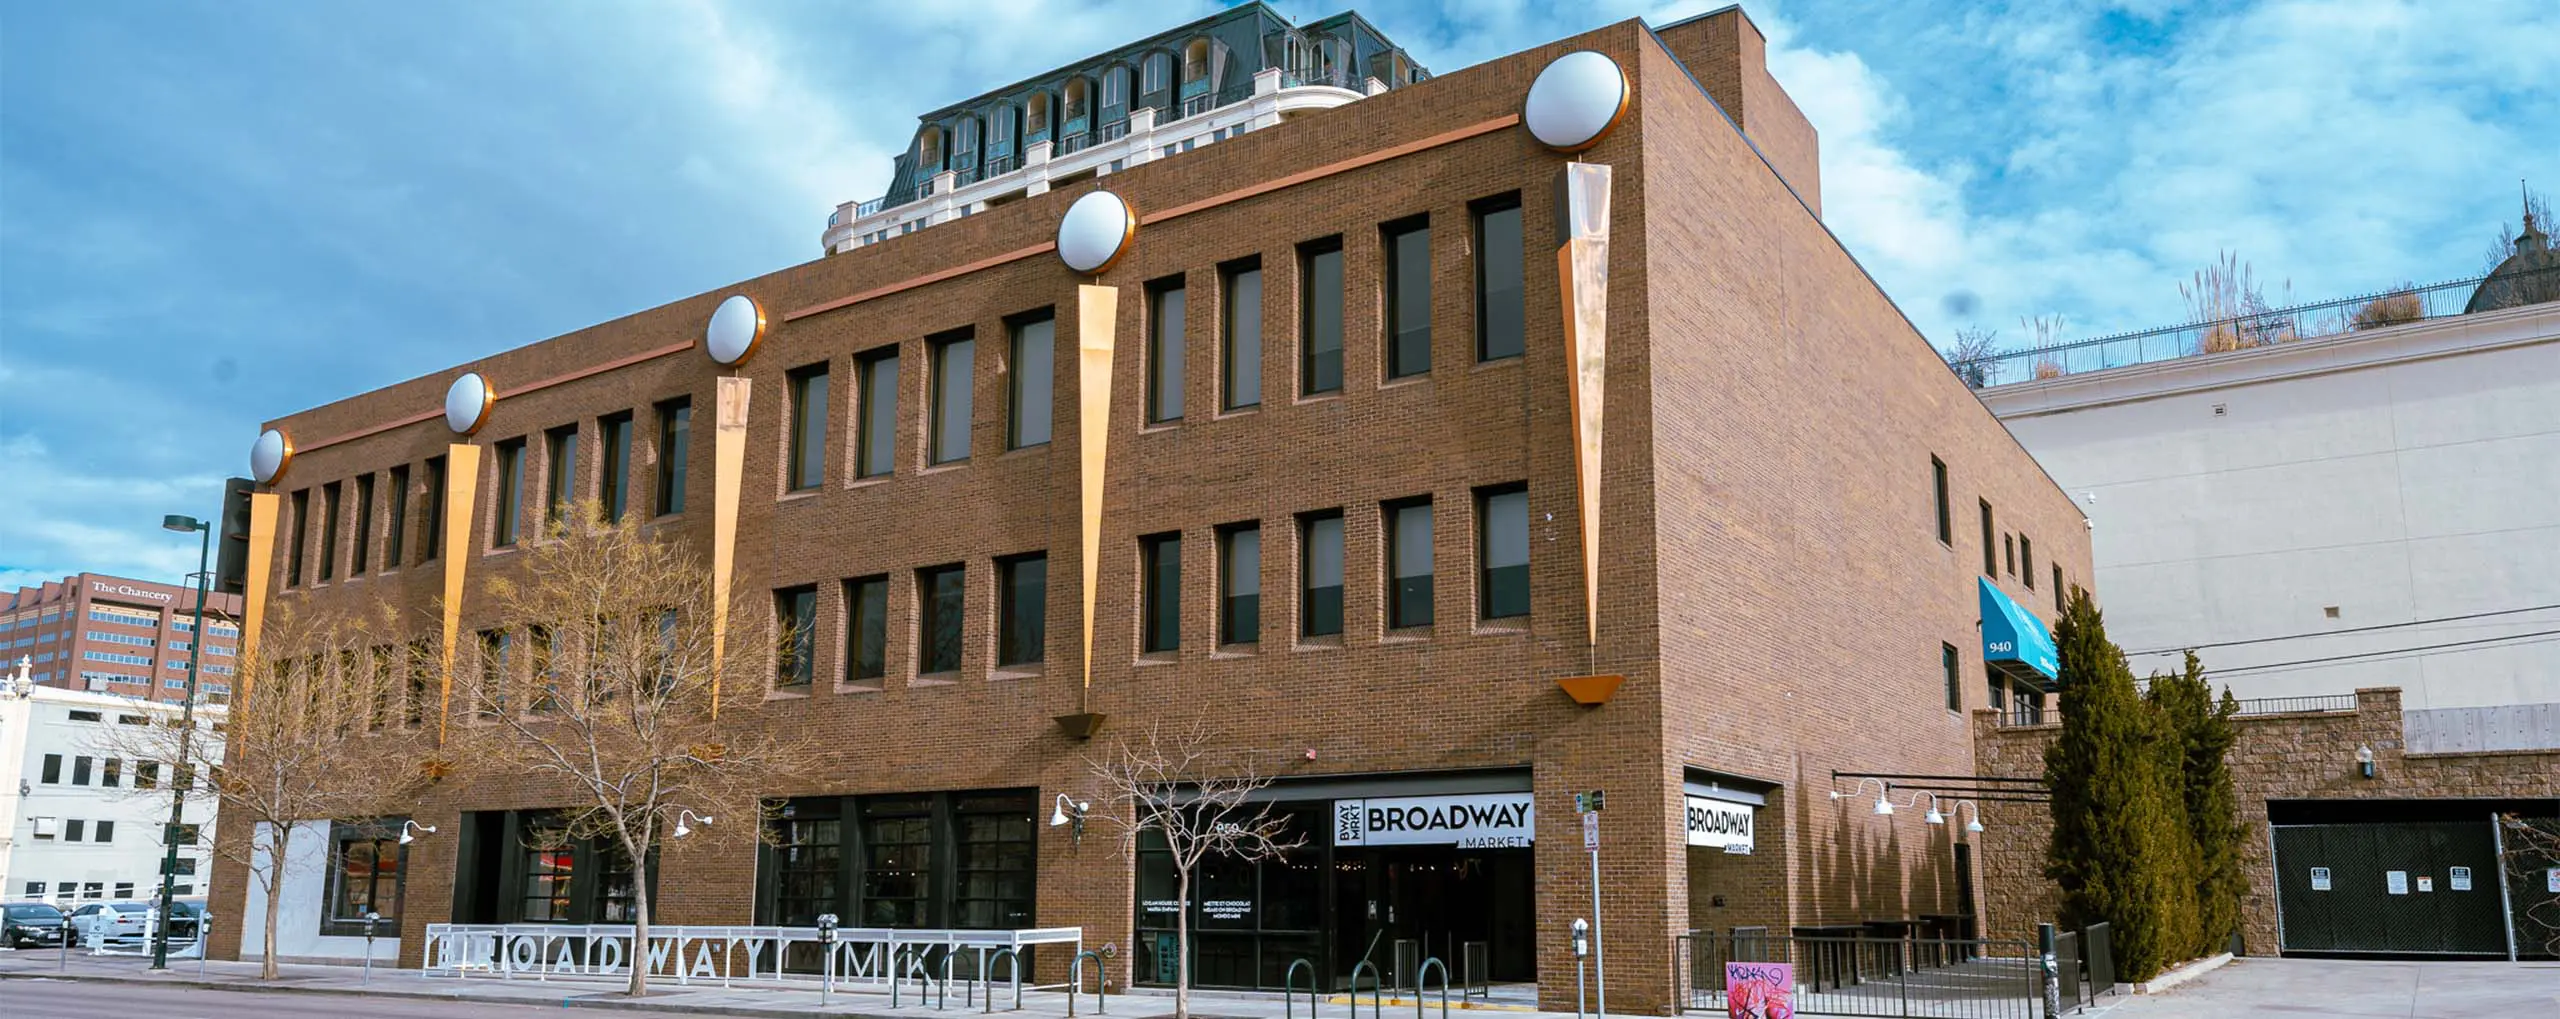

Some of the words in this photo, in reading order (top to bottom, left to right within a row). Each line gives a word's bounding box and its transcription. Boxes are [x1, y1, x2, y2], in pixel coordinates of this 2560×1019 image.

[92, 581, 116, 593] The
[118, 585, 173, 603] Chancery
[1990, 641, 2012, 653] 940
[1340, 805, 1350, 841] BWAY
[1350, 804, 1360, 840] MRKT
[1367, 802, 1531, 832] BROADWAY
[1689, 806, 1751, 837] BROADWAY
[1465, 836, 1524, 849] MARKET
[438, 935, 765, 979] BROADWAY
